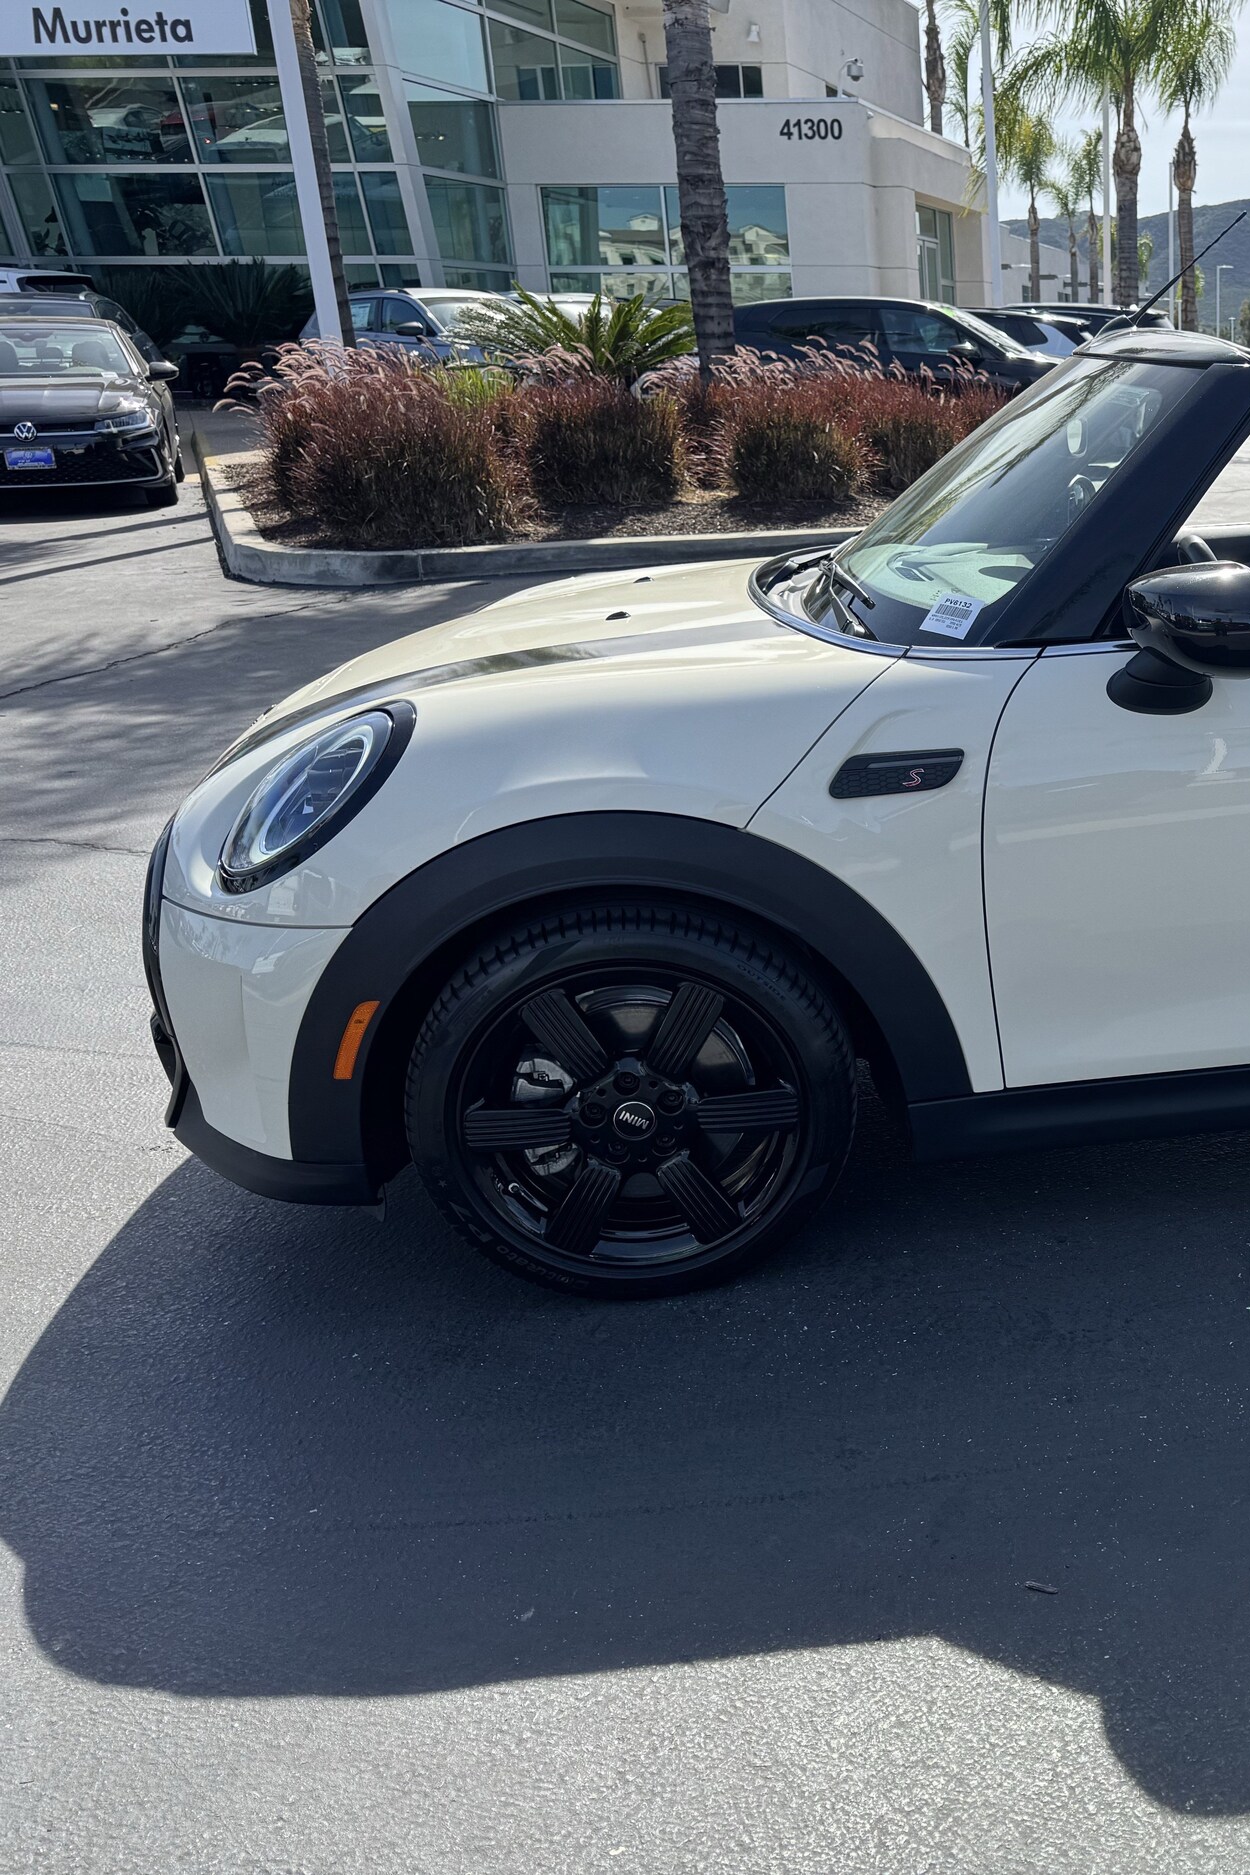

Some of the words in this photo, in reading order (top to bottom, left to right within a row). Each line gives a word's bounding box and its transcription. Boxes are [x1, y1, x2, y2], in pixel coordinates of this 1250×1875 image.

[32, 7, 194, 44] Murrieta
[779, 118, 843, 140] 41300
[902, 768, 925, 787] S
[619, 1110, 650, 1130] MINI
